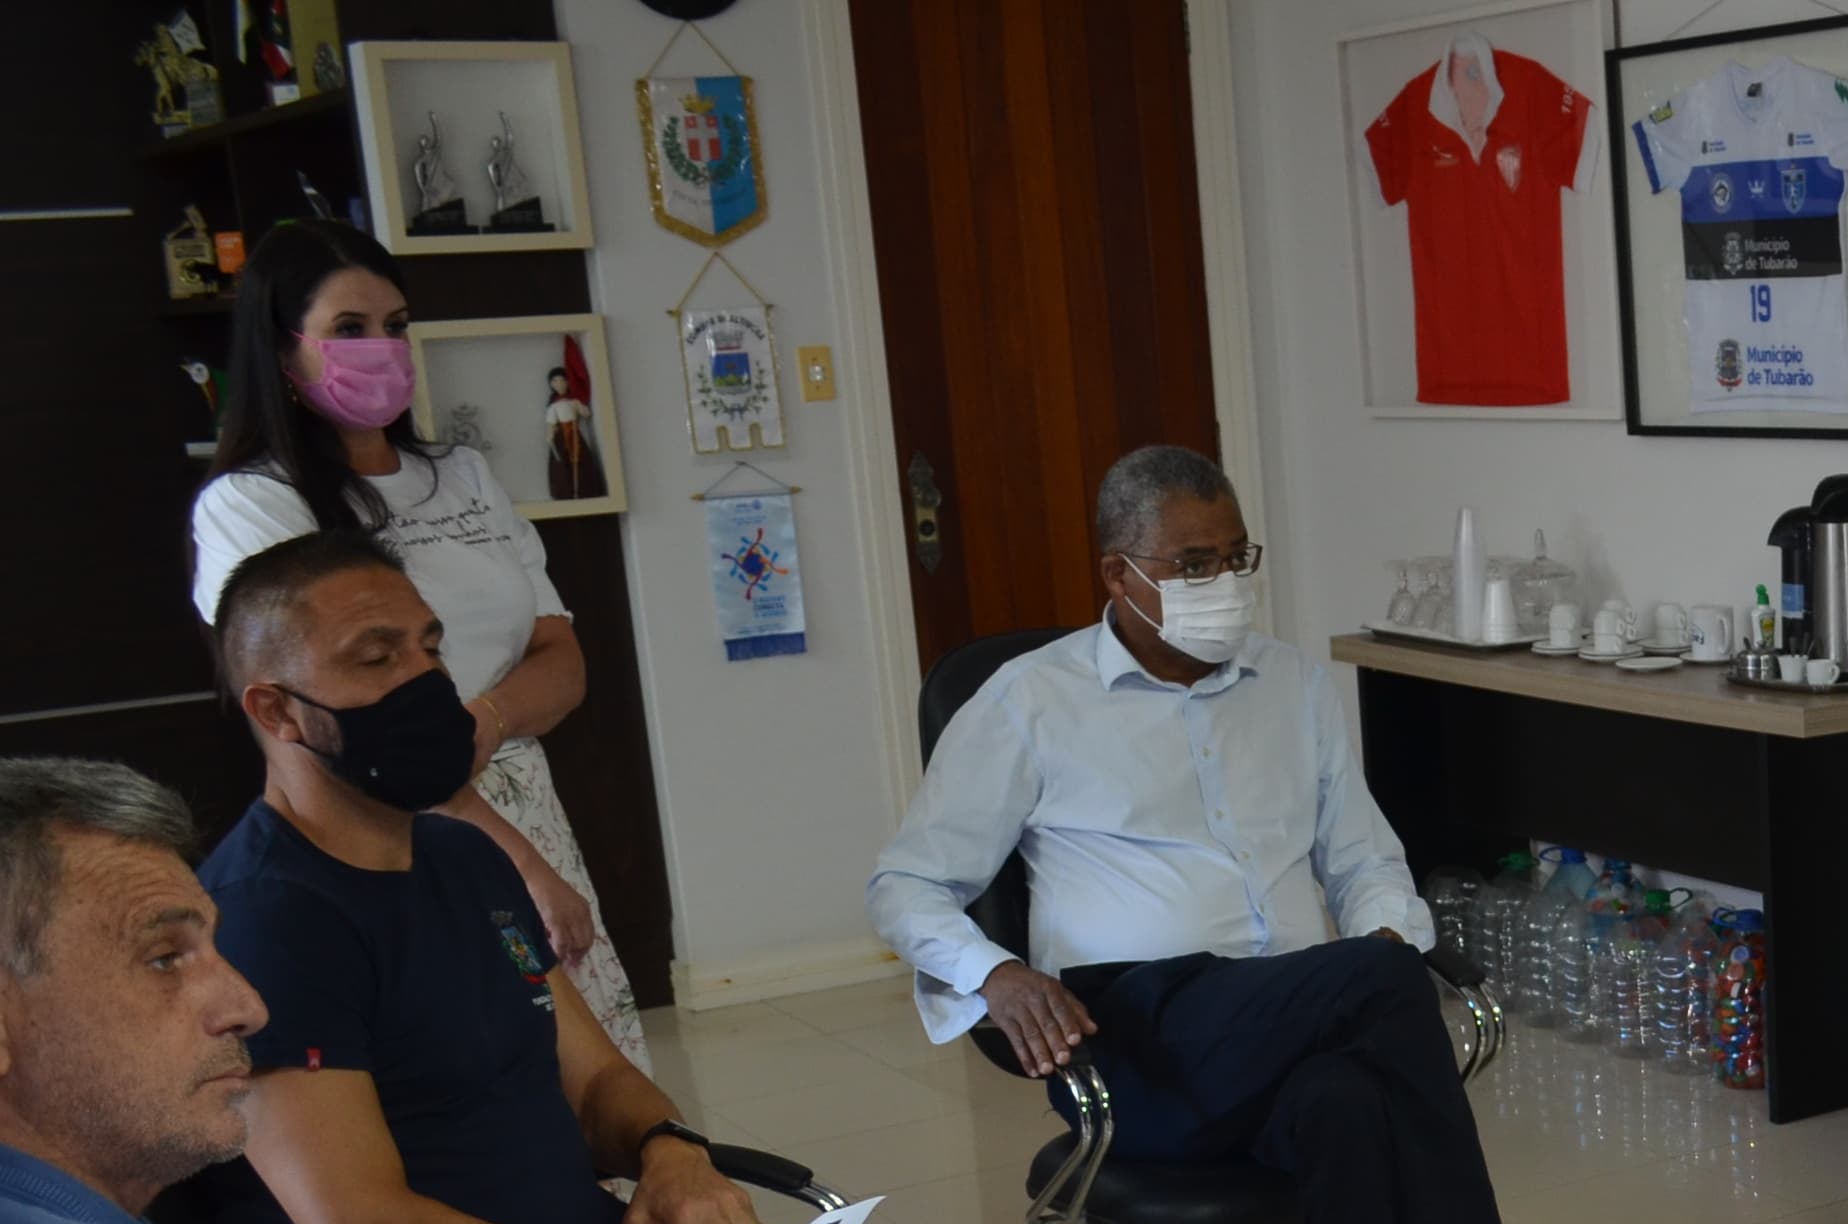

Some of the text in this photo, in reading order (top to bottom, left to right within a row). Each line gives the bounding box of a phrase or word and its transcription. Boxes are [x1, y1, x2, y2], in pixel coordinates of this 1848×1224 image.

[1745, 256, 1757, 270] de
[1750, 284, 1771, 322] 19
[1747, 368, 1814, 386] de Tubarão
